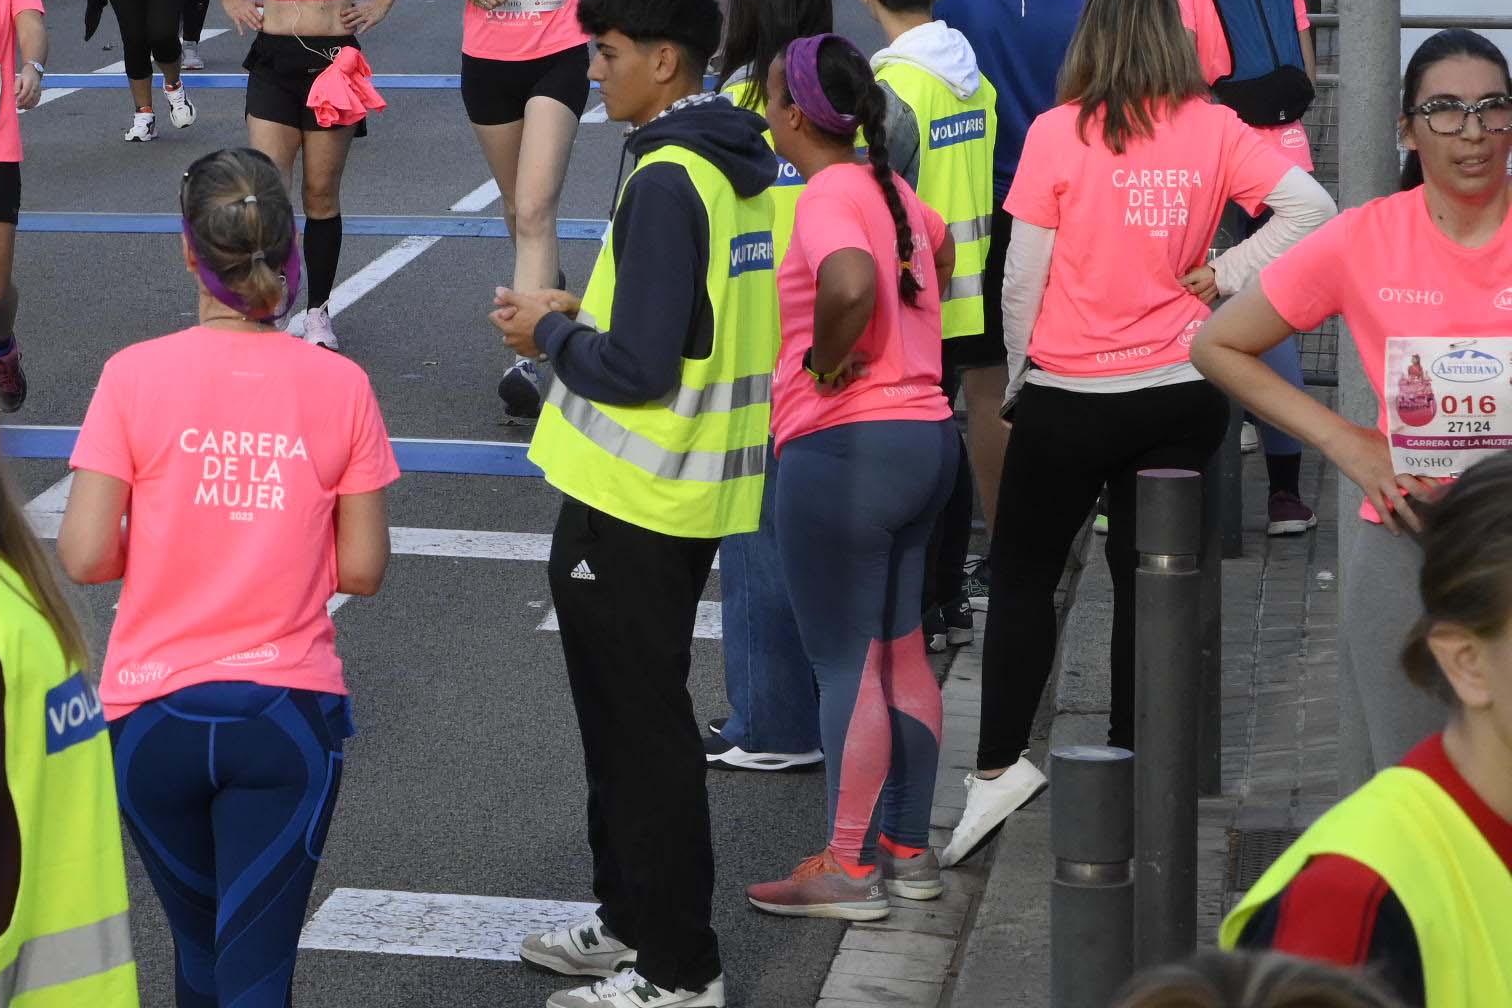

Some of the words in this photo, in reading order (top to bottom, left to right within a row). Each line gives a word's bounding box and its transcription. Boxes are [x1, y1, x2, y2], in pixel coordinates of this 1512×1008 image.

[1112, 168, 1203, 188] CARRERA
[1128, 189, 1155, 208] DE
[1163, 189, 1186, 208] LA
[1124, 208, 1189, 226] MUJER
[1378, 287, 1444, 305] OYSHO
[1096, 346, 1152, 364] OYSHO
[1437, 361, 1498, 375] ASTURIANA
[1441, 395, 1496, 414] 016
[1447, 421, 1491, 433] 27124
[180, 428, 308, 461] CARRERA
[1406, 439, 1451, 447] CARRERA
[1452, 439, 1466, 447] DE
[1467, 438, 1480, 446] LA
[203, 456, 238, 481] DE
[250, 459, 282, 483] LA
[1405, 455, 1454, 468] OYSHO
[194, 482, 285, 510] MUJER
[570, 571, 596, 580] adidas
